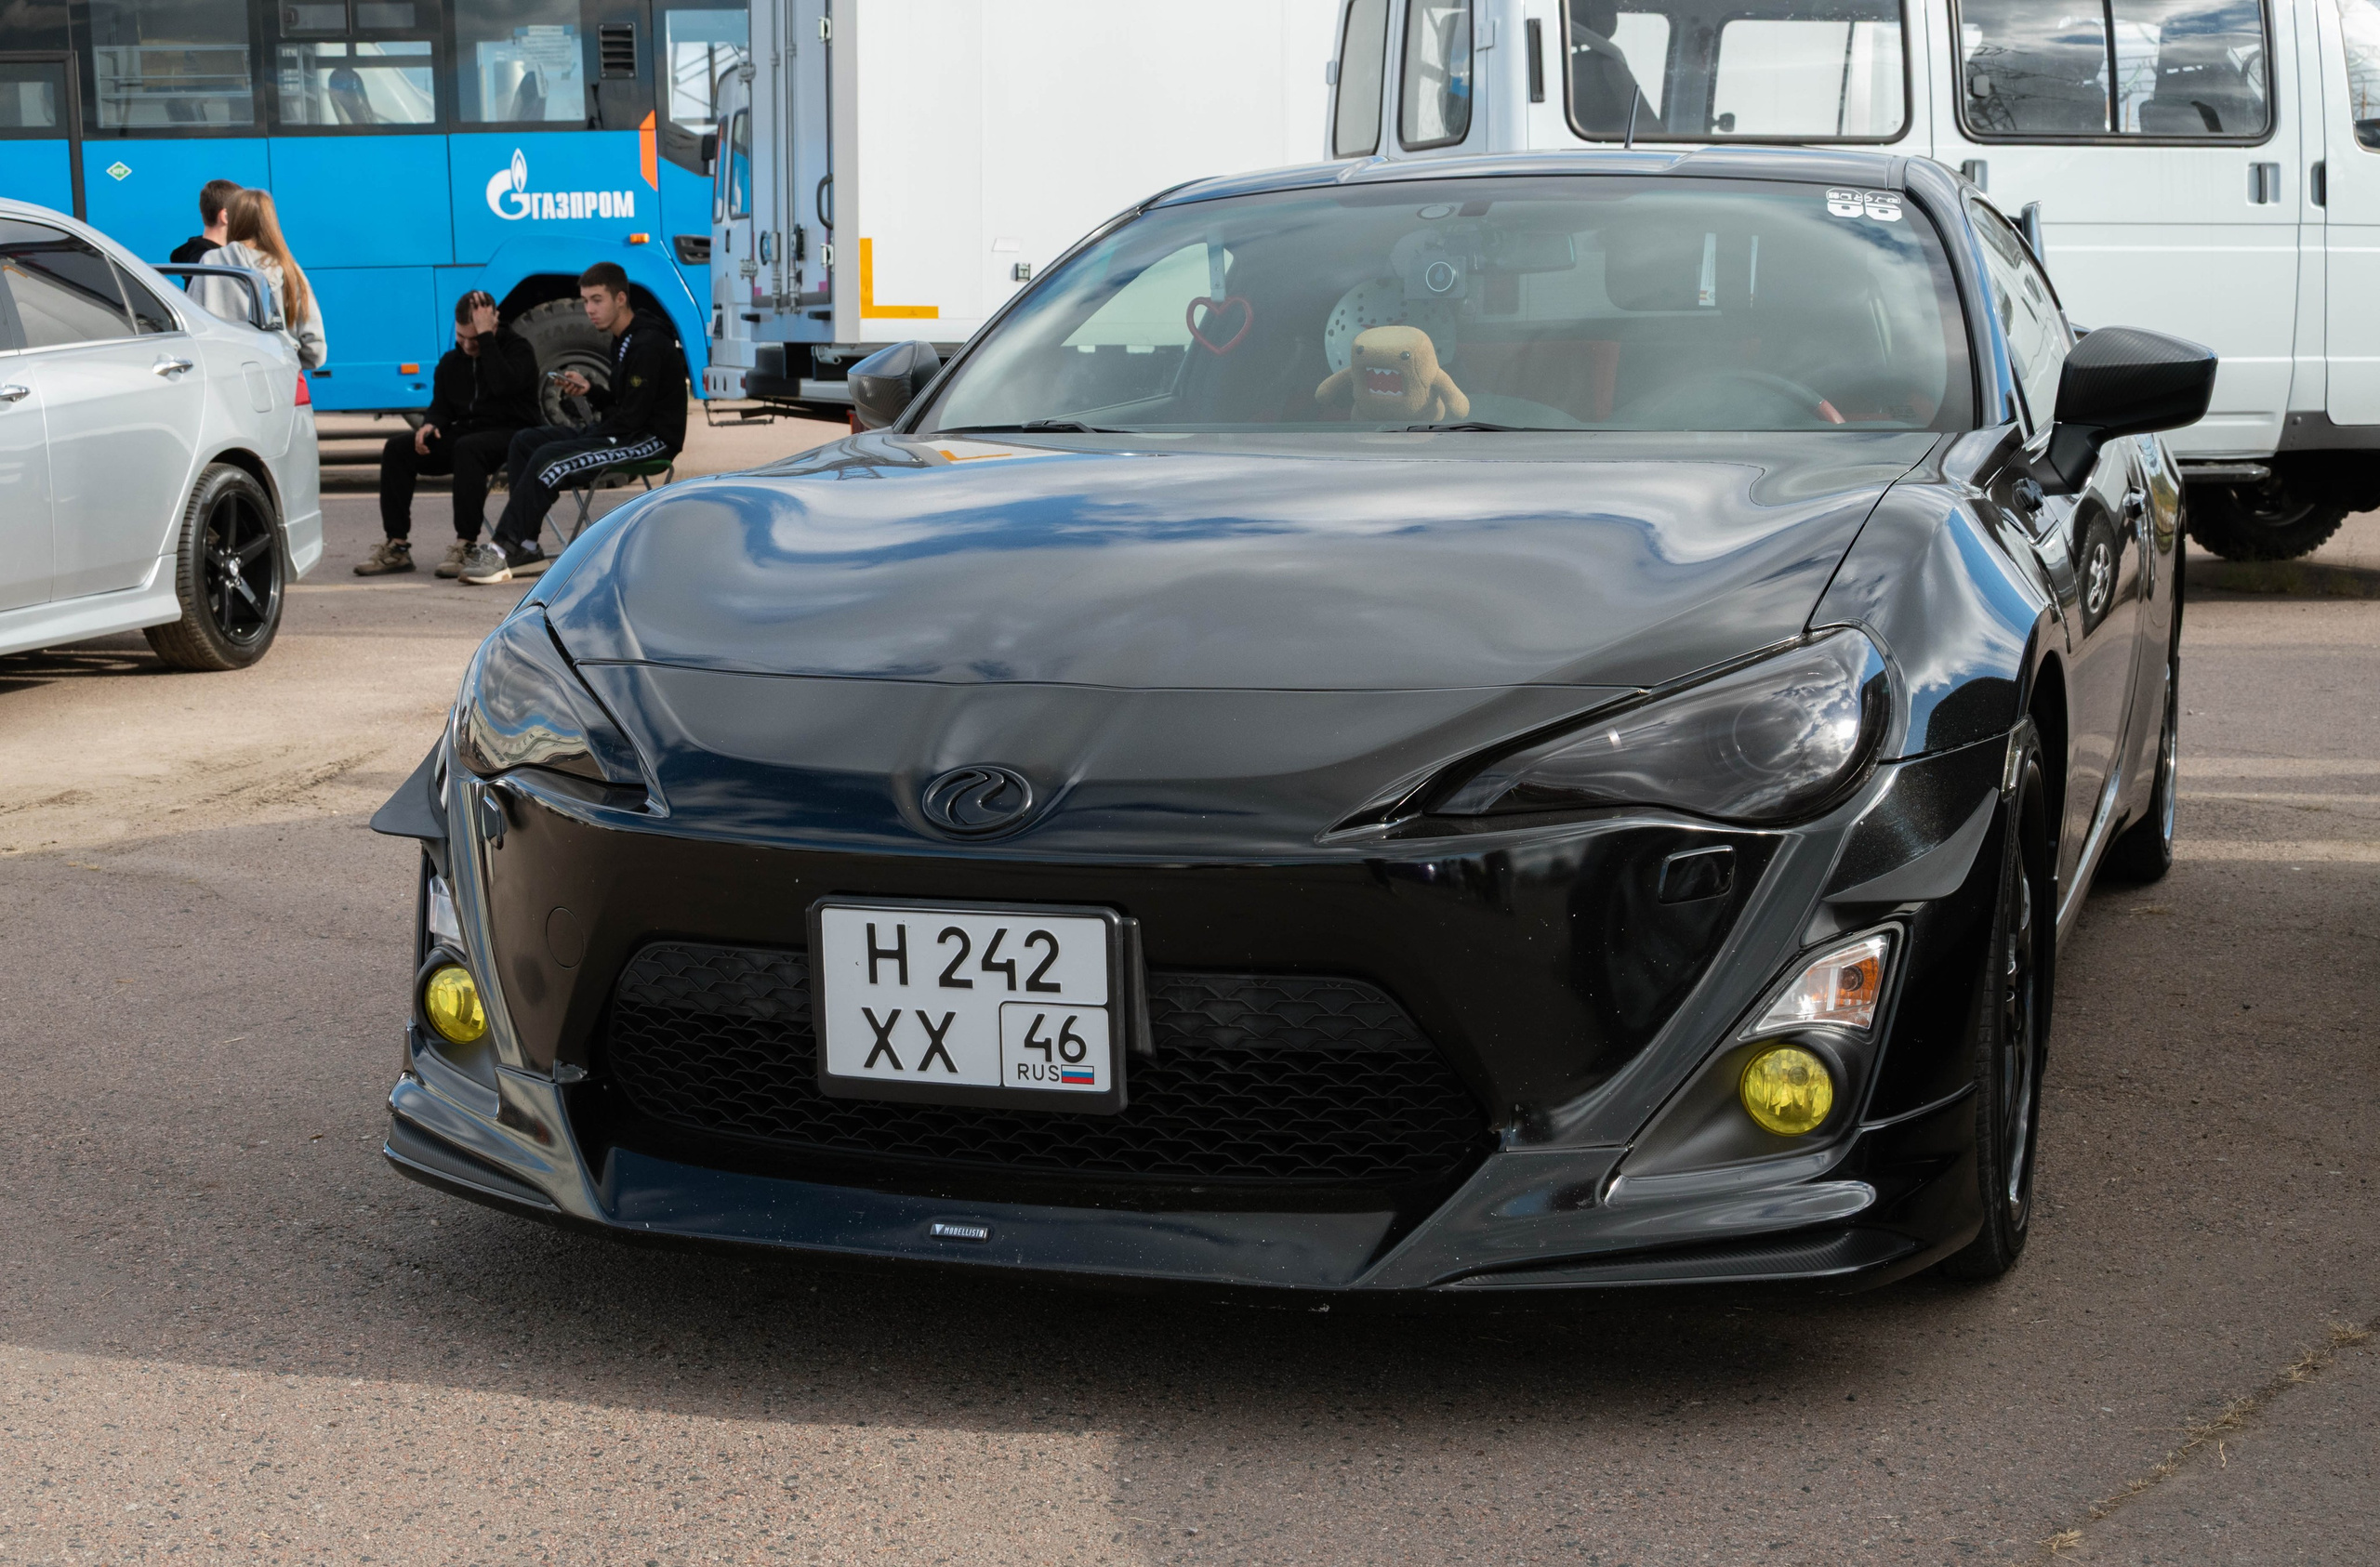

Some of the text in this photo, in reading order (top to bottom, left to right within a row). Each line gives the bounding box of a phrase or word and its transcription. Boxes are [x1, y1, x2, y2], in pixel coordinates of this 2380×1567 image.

[530, 191, 635, 220] ГАЗПРОМ
[866, 922, 1062, 994] Н 242
[861, 1007, 959, 1074] ХХ
[1024, 1013, 1087, 1064] 46
[1017, 1062, 1060, 1083] RUS
